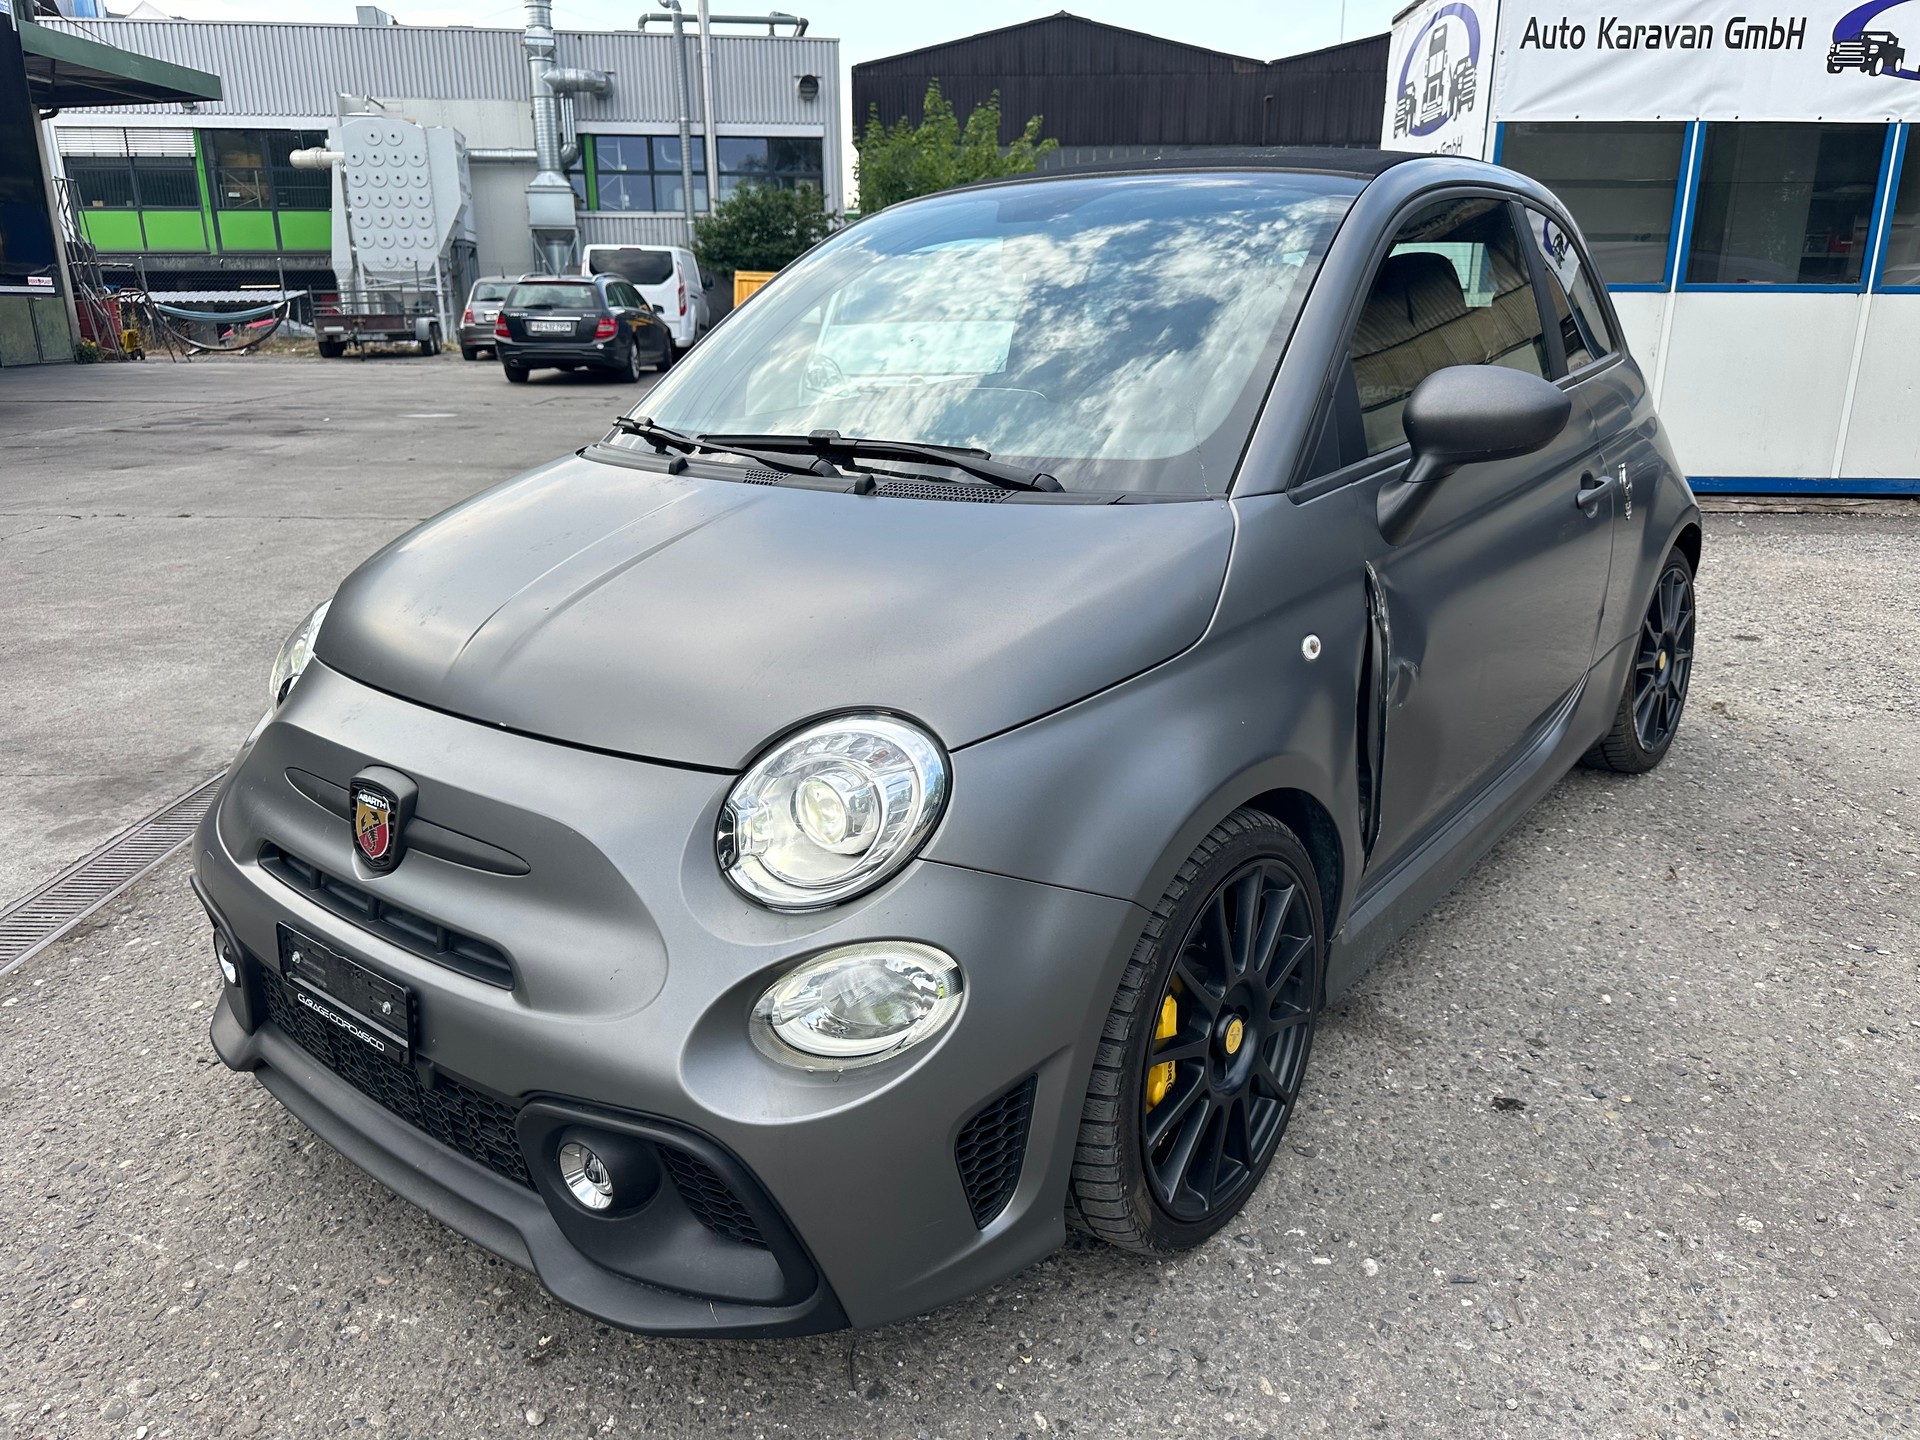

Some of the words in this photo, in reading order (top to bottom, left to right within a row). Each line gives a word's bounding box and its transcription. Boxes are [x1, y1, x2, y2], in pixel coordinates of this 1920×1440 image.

[1519, 16, 1586, 50] Auto
[1597, 16, 1714, 50] Karavan
[1724, 16, 1808, 50] GmbH
[1440, 135, 1463, 156] GmbH
[358, 793, 387, 809] ABARTH
[297, 993, 329, 1019] GARAGE
